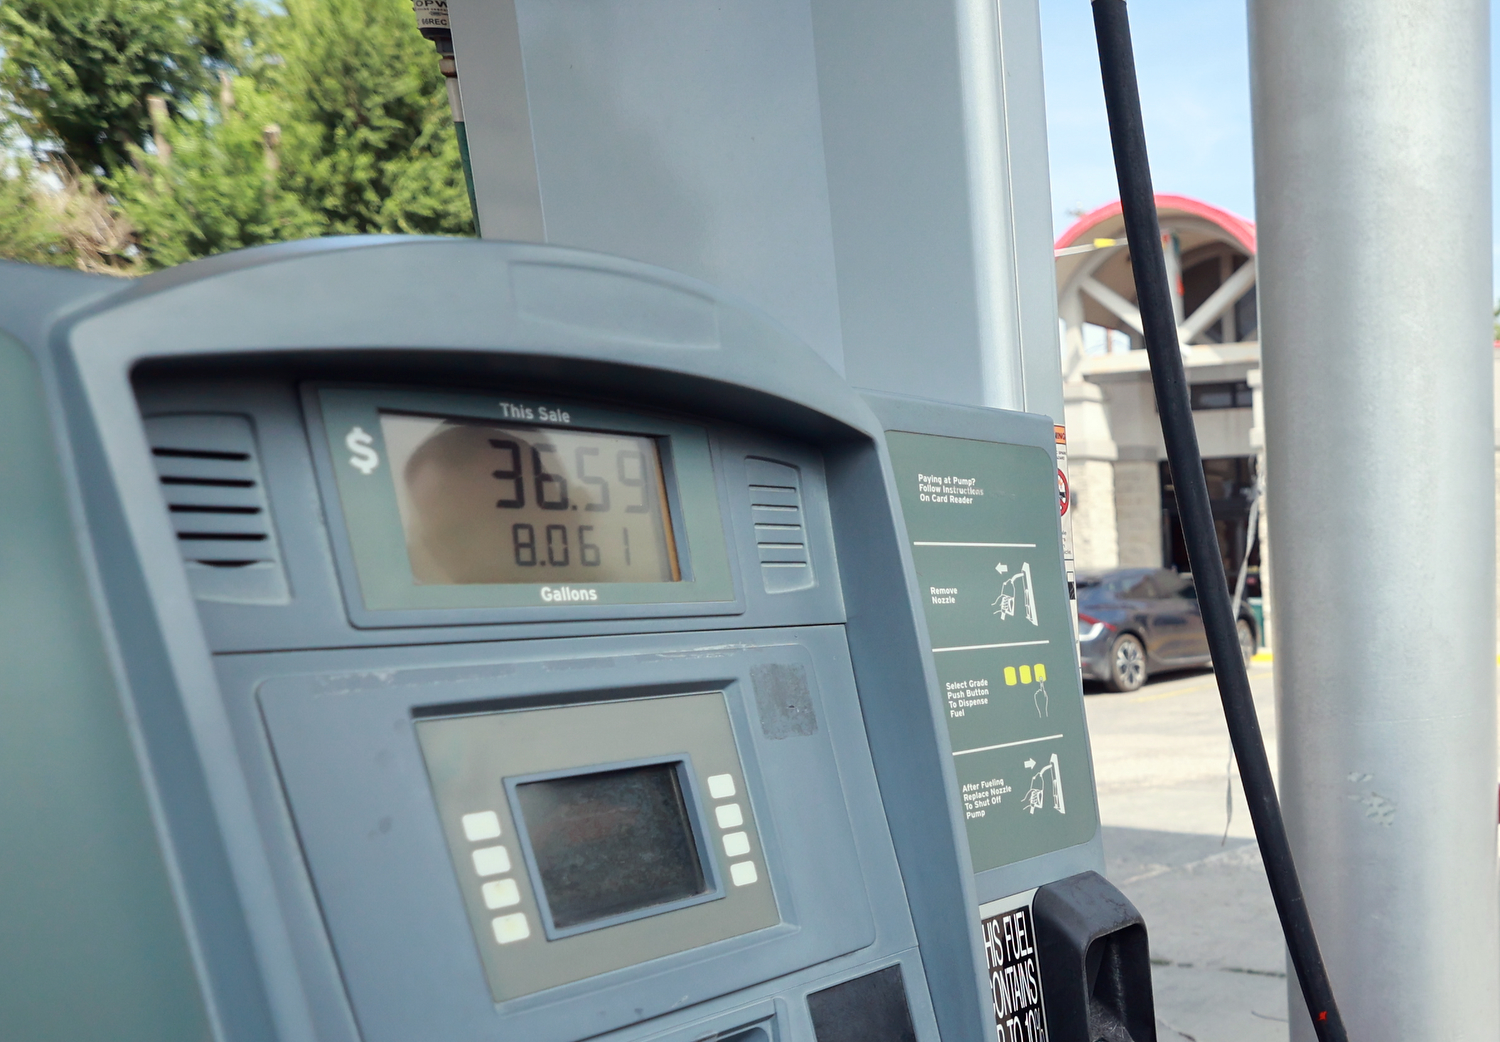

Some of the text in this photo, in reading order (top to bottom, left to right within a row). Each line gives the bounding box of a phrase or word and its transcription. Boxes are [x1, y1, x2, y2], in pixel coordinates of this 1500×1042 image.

[500, 402, 571, 423] This Sale
[345, 427, 378, 473] $
[488, 439, 650, 514] 36.59
[918, 474, 976, 487] Paying at Pump?
[919, 484, 984, 496] Follow Instructions
[920, 493, 973, 504] On Card Reader
[512, 523, 631, 567] 8.061
[541, 587, 598, 602] Gallons
[930, 586, 958, 595] Remove
[931, 596, 956, 604] Nozzle
[946, 679, 988, 691] Select Grade
[947, 688, 989, 700] Push Button
[948, 697, 988, 709] To Dispense
[950, 709, 965, 718] Fuel
[962, 778, 1004, 793] After Fueling
[963, 786, 1012, 802] Replace Nozzle
[965, 796, 1001, 811] To Shut Off
[966, 810, 986, 820] Pump
[982, 911, 1033, 969] HIS FUEL
[990, 958, 1038, 1018] ONTAINS
